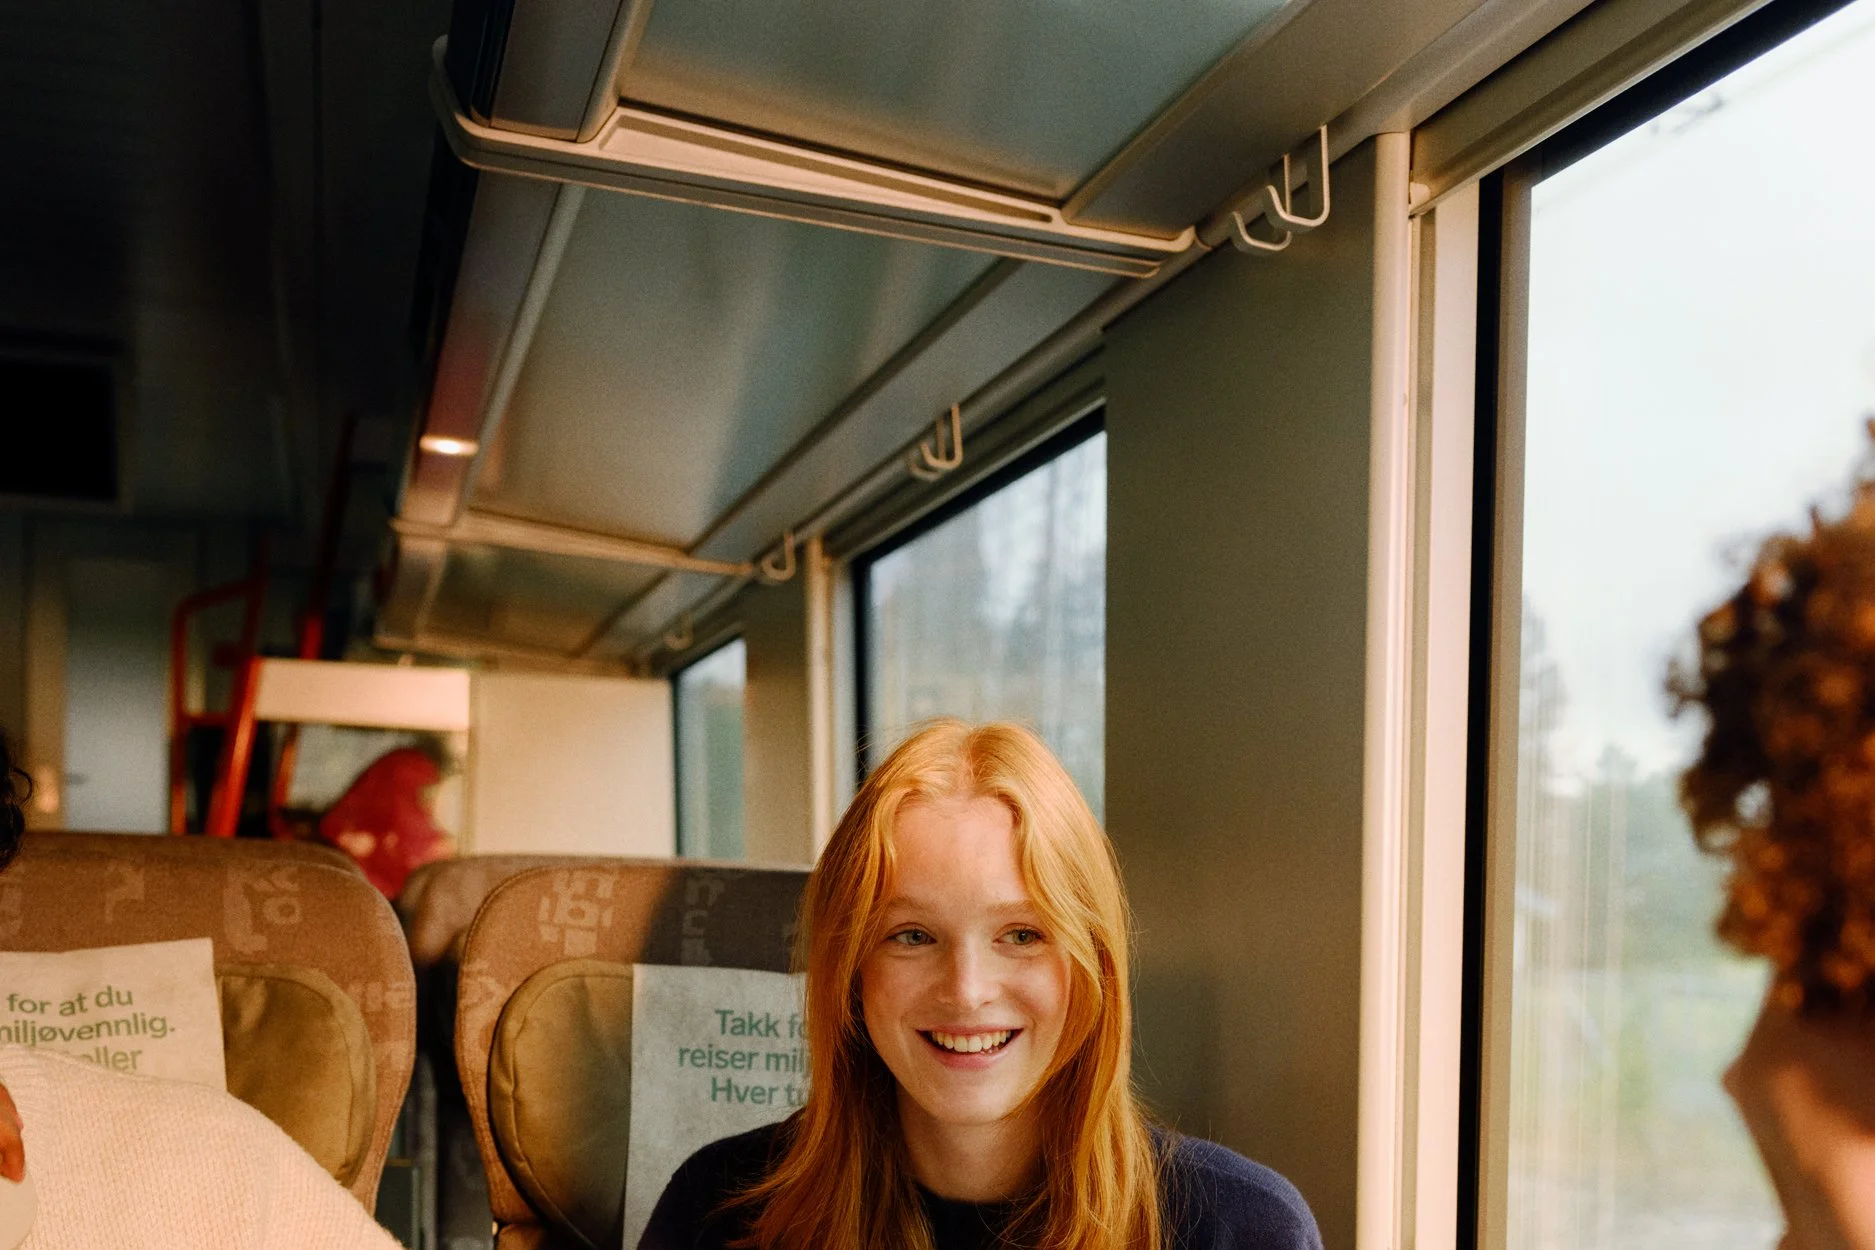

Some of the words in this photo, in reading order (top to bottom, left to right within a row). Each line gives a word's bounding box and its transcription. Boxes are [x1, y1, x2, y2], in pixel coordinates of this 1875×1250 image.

[7, 993, 51, 1014] for
[59, 993, 88, 1017] at
[95, 985, 133, 1008] du
[715, 1008, 780, 1038] Takk
[678, 1044, 760, 1071] reiser
[710, 1076, 779, 1105] Hver
